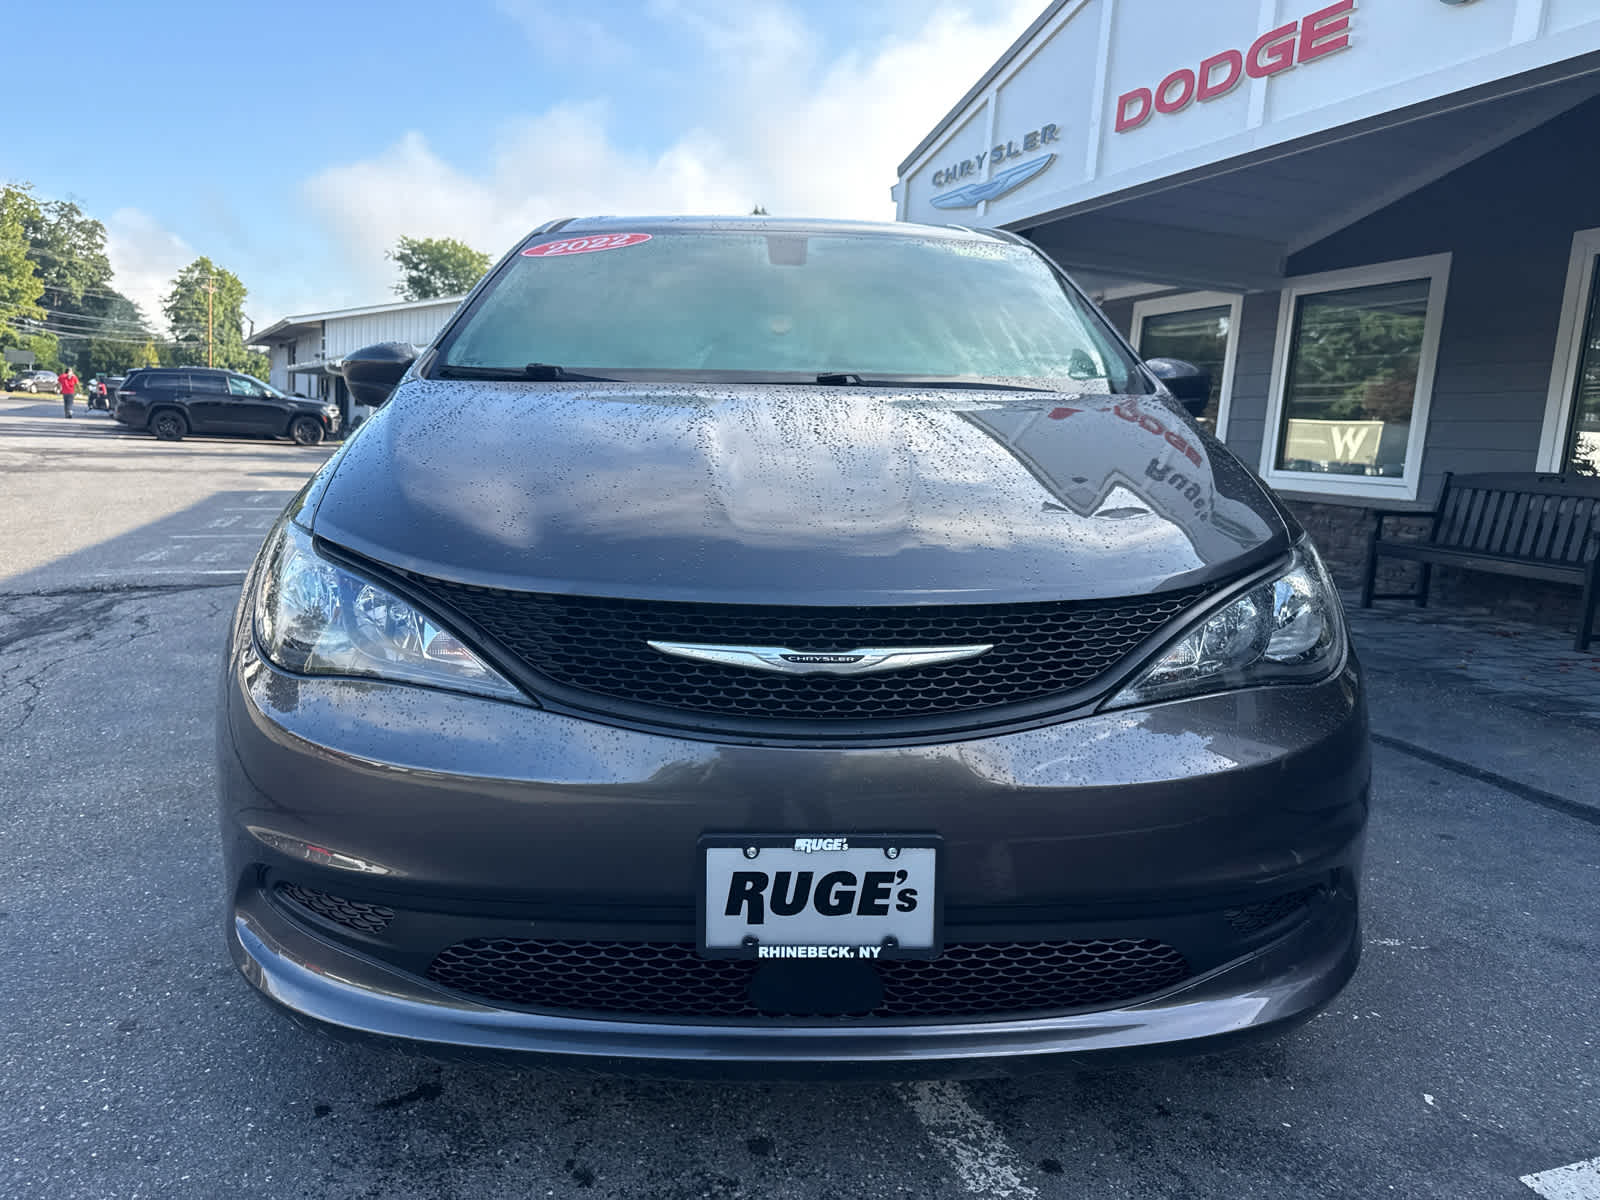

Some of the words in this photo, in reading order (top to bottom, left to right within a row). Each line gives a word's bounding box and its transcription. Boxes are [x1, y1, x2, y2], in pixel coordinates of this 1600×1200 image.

[1114, 0, 1354, 133] DODGE
[932, 123, 1058, 186] CHRYSLER
[544, 233, 631, 255] 2022
[724, 869, 918, 925] RUGE's
[758, 946, 855, 959] RHINEBECK,
[859, 946, 881, 959] NY
